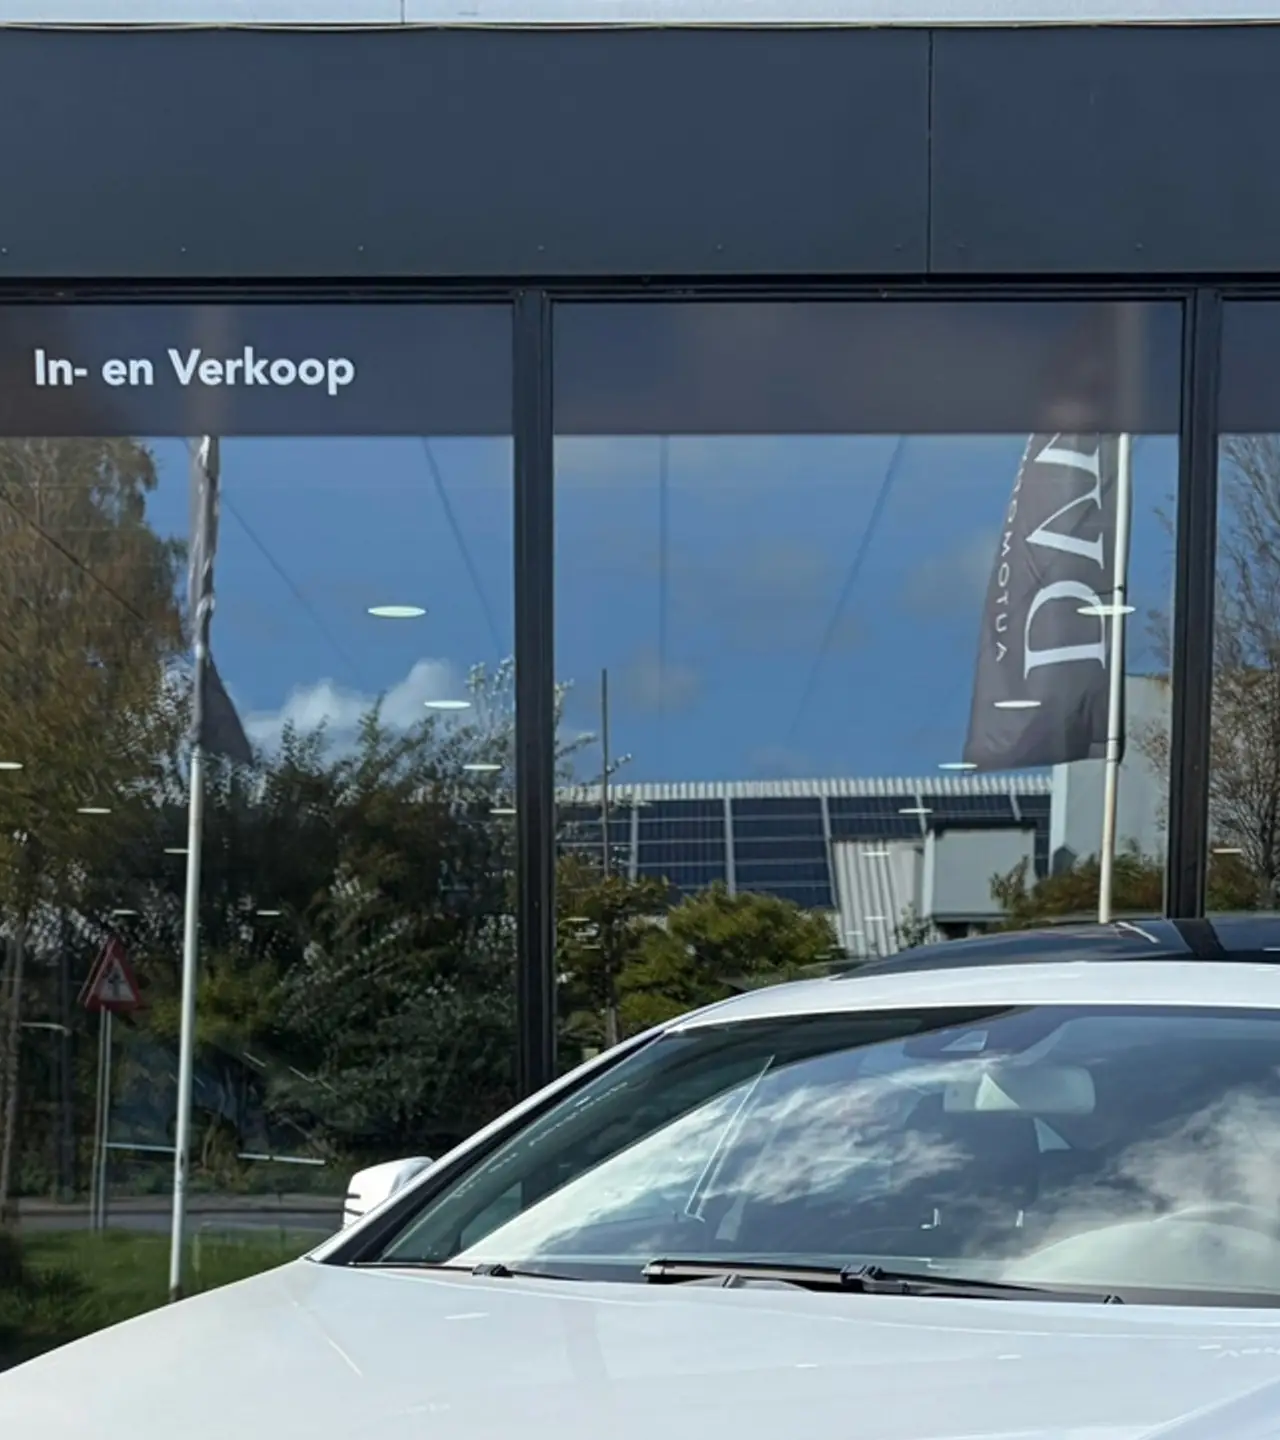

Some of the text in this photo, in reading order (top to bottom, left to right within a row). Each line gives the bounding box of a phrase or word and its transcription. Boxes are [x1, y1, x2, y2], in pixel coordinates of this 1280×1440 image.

[34, 346, 355, 396] In- en Verkoop
